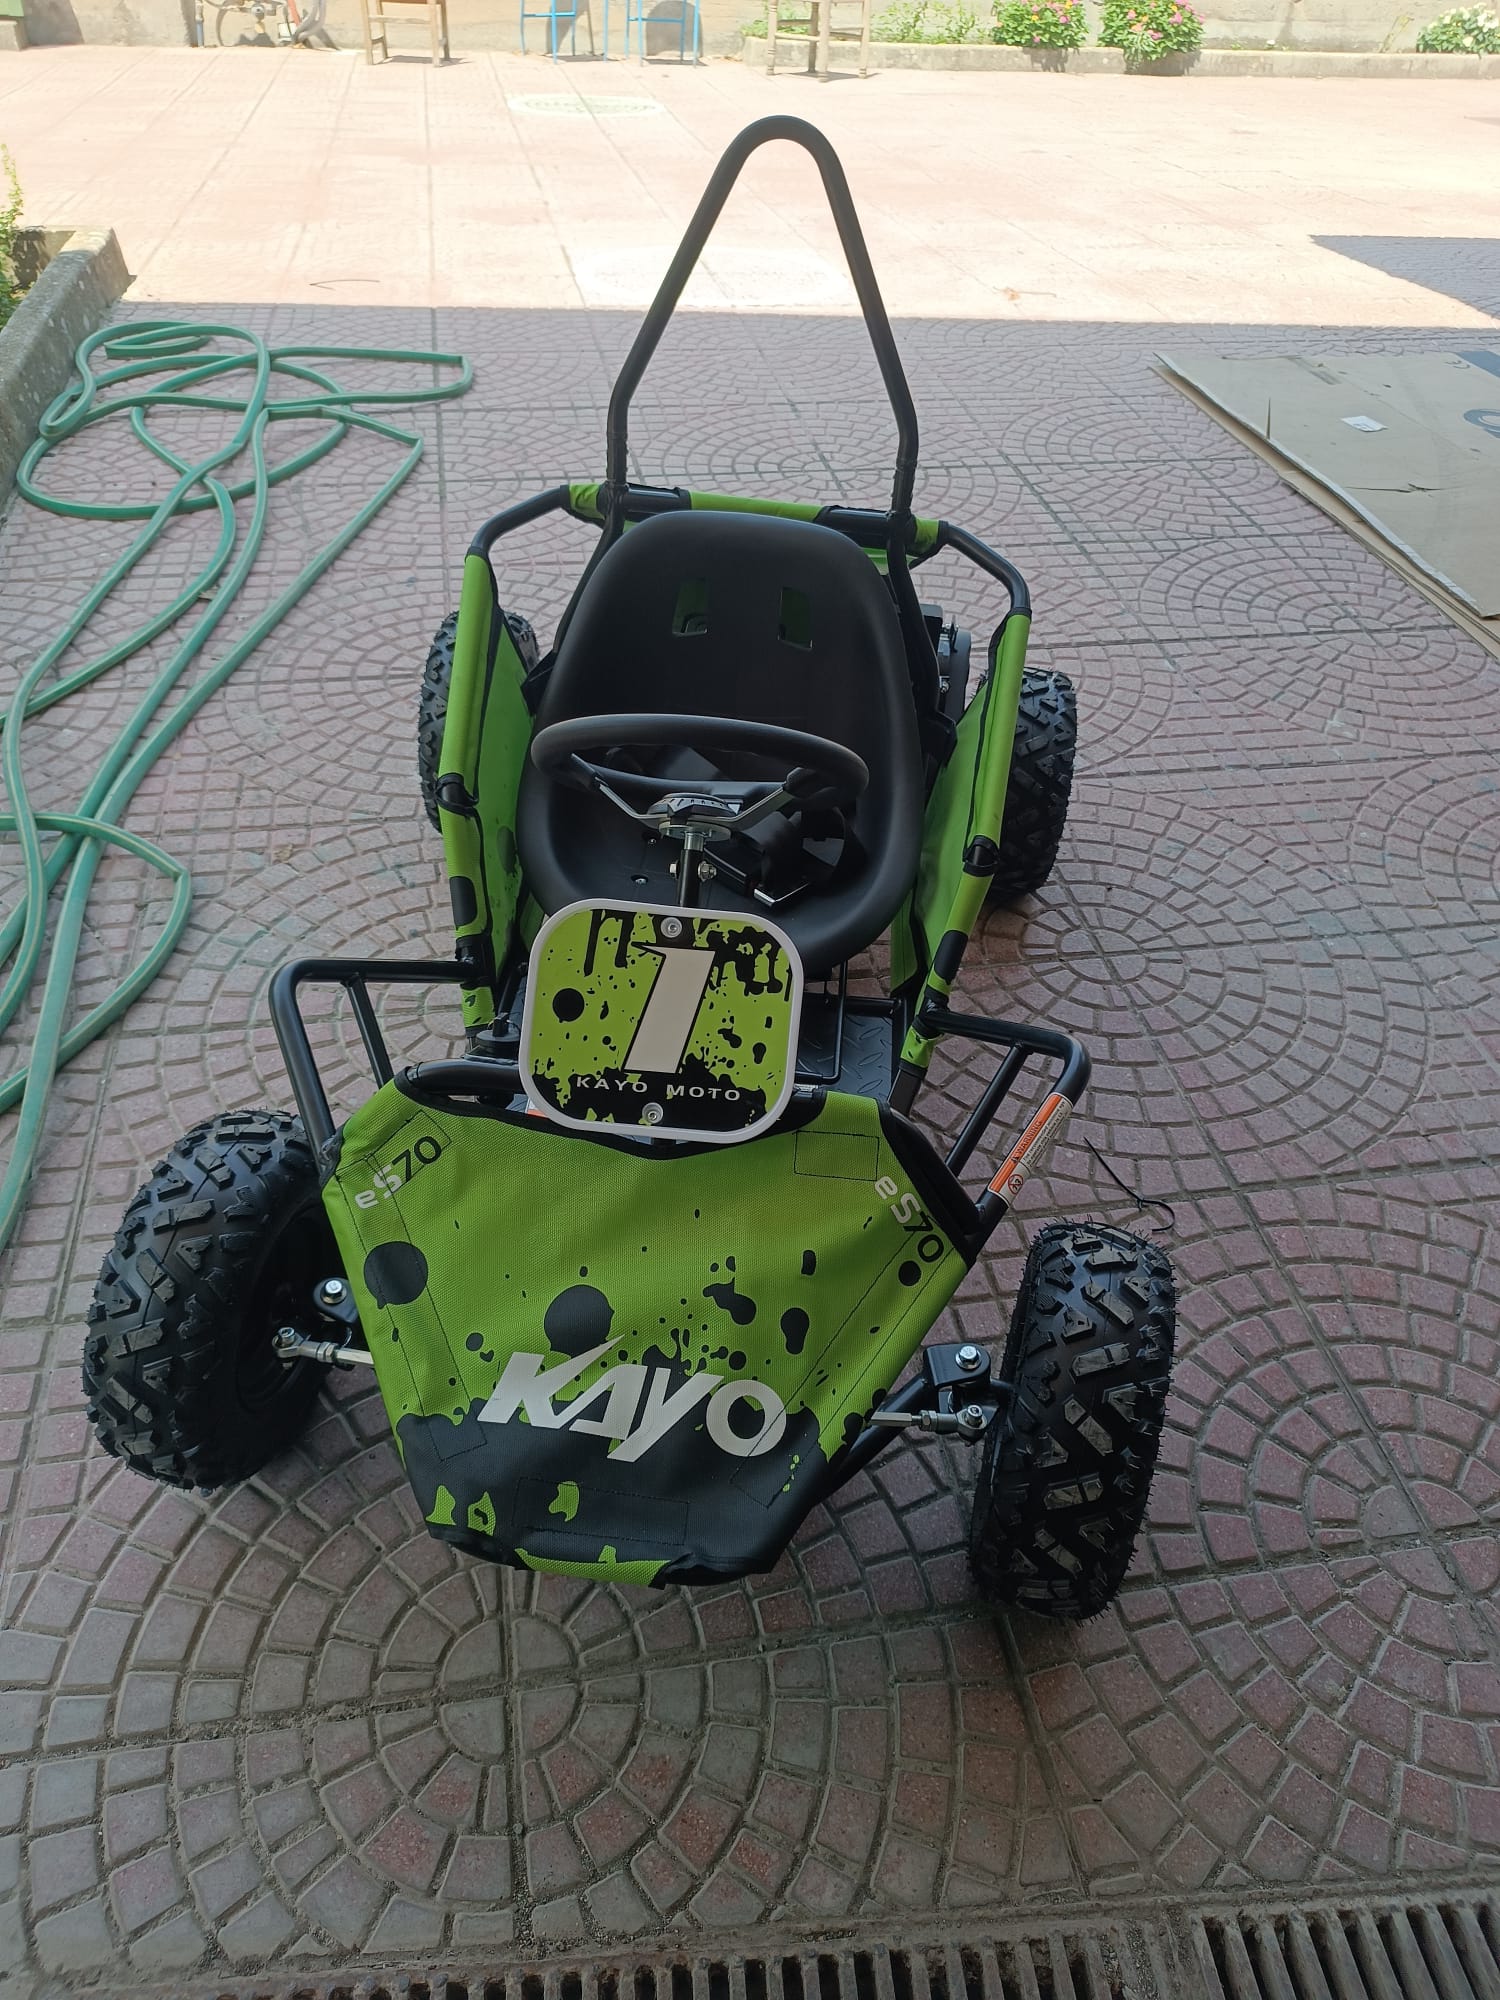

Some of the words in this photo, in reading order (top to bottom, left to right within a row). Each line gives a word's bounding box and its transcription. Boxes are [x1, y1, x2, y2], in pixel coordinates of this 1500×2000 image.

[623, 942, 716, 1074] 1
[576, 1076, 648, 1094] KAYO
[666, 1084, 741, 1102] MOTO
[1015, 1119, 1043, 1155] WARNING
[874, 1176, 944, 1263] eS70
[477, 1334, 787, 1462] KAYO
